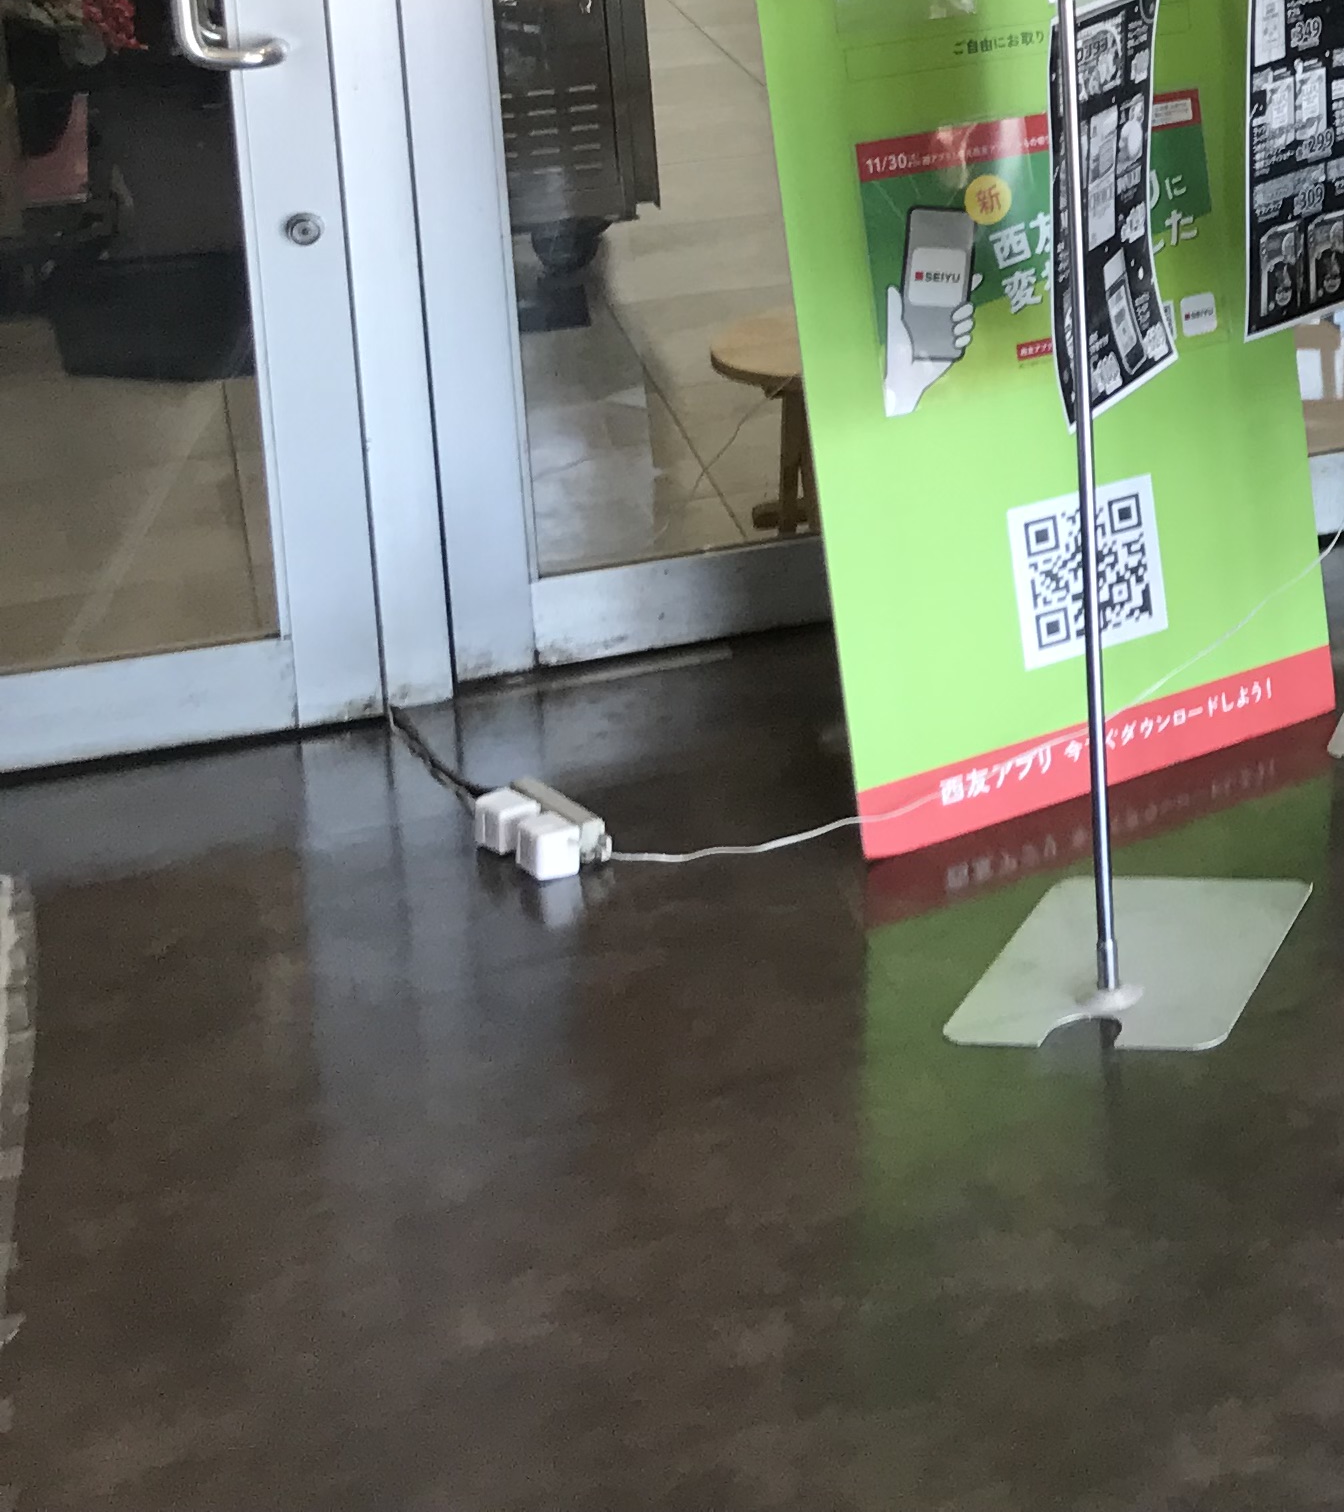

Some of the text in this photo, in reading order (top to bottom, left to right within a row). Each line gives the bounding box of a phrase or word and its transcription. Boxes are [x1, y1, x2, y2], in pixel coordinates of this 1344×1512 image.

[952, 30, 1046, 56] ご自由にお取り
[975, 183, 1002, 215] 新
[924, 270, 961, 285] SEIYU
[1001, 262, 1051, 315] 変
[938, 677, 1274, 806] 西友アプリ 今ぐダウンロードしよう!
